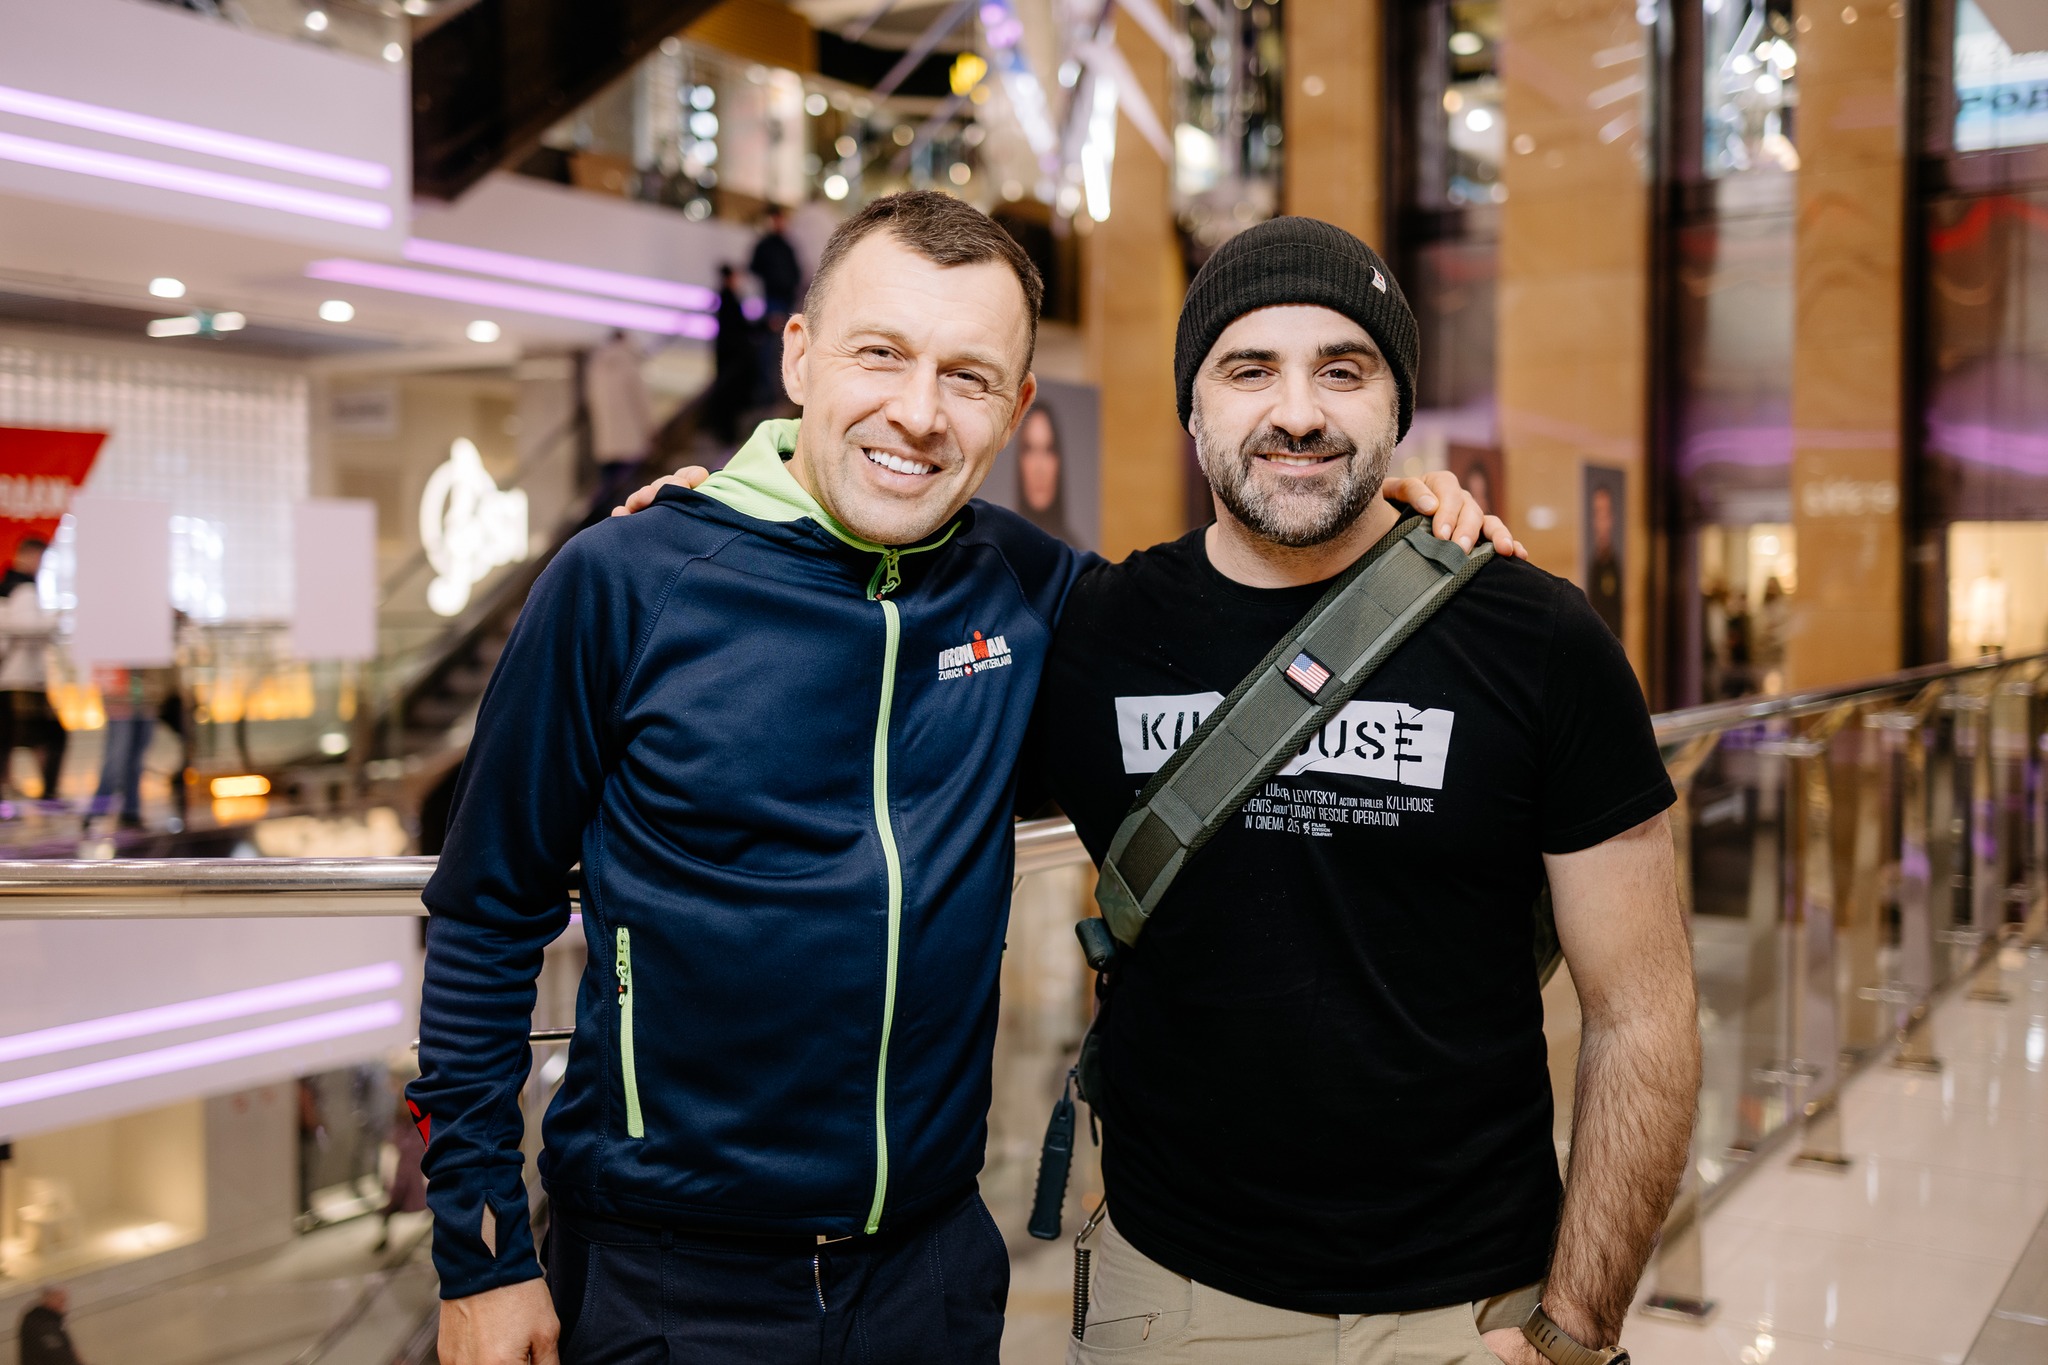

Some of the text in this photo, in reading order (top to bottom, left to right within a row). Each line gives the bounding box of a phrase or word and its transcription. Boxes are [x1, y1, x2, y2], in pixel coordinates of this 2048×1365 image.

[938, 654, 1012, 681] ZURICH SWITZERLAND
[1292, 788, 1337, 806] LEVYTSKYI
[1338, 797, 1358, 807] ACTION
[1359, 798, 1384, 809] THRILLER
[1255, 815, 1284, 831] CINEMA
[1318, 806, 1349, 823] RESCUE
[1352, 810, 1400, 827] OPERATION
